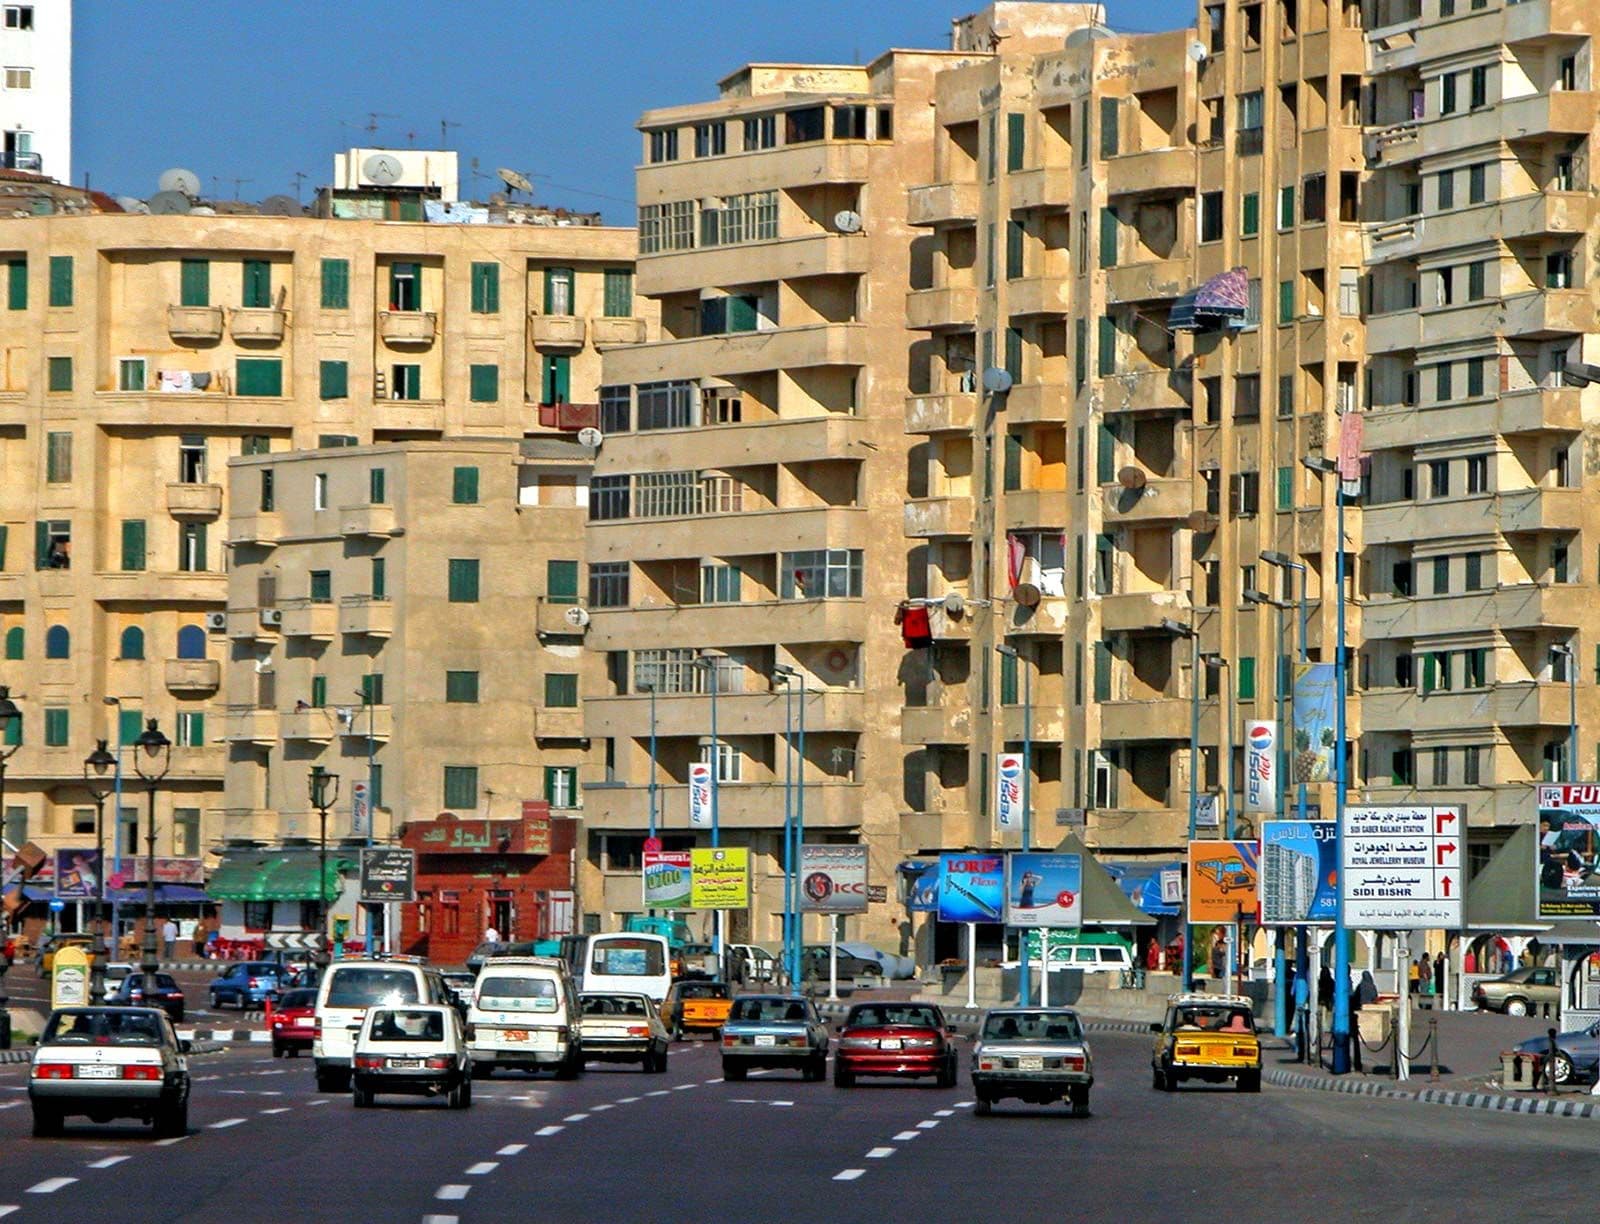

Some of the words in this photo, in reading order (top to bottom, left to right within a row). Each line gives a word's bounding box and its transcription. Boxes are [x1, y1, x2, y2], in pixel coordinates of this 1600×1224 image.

[1250, 752, 1261, 806] PEPSI
[693, 785, 701, 822] PEPSI
[1000, 779, 1010, 824] PEPSI
[1350, 825, 1361, 834] SIDI
[1380, 825, 1402, 834] RAILWAY
[1403, 825, 1425, 834] STATION
[1353, 842, 1394, 855] المجوهرات
[1395, 842, 1428, 853] متحف
[1351, 857, 1369, 865] ROYAL
[1403, 857, 1426, 865] MUSEUM
[1361, 874, 1387, 886] بشر
[835, 882, 865, 894] ICC
[1353, 888, 1375, 897] SIDI
[1378, 888, 1412, 897] BISHR
